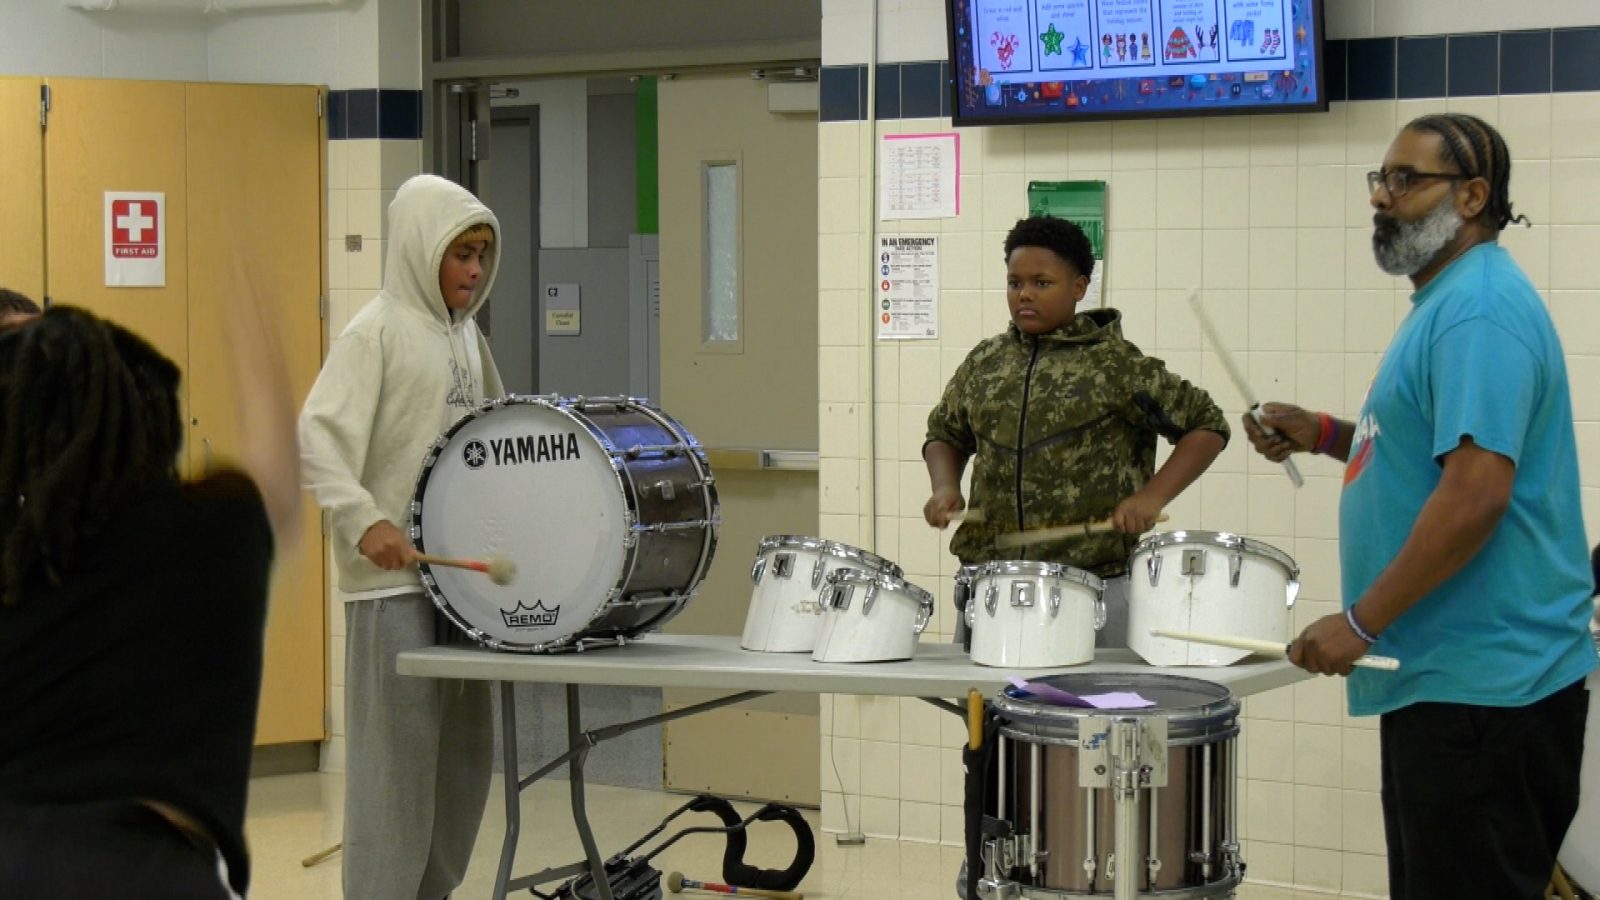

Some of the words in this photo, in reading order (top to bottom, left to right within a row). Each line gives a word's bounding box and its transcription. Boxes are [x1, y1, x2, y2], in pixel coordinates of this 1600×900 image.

[881, 237, 888, 246] IN
[889, 237, 898, 246] AN
[898, 237, 935, 246] EMERGENCY
[115, 247, 139, 255] FIRST
[141, 247, 156, 255] AID
[547, 287, 558, 297] C2
[489, 432, 581, 466] YAMAHA
[509, 612, 553, 625] REMO
